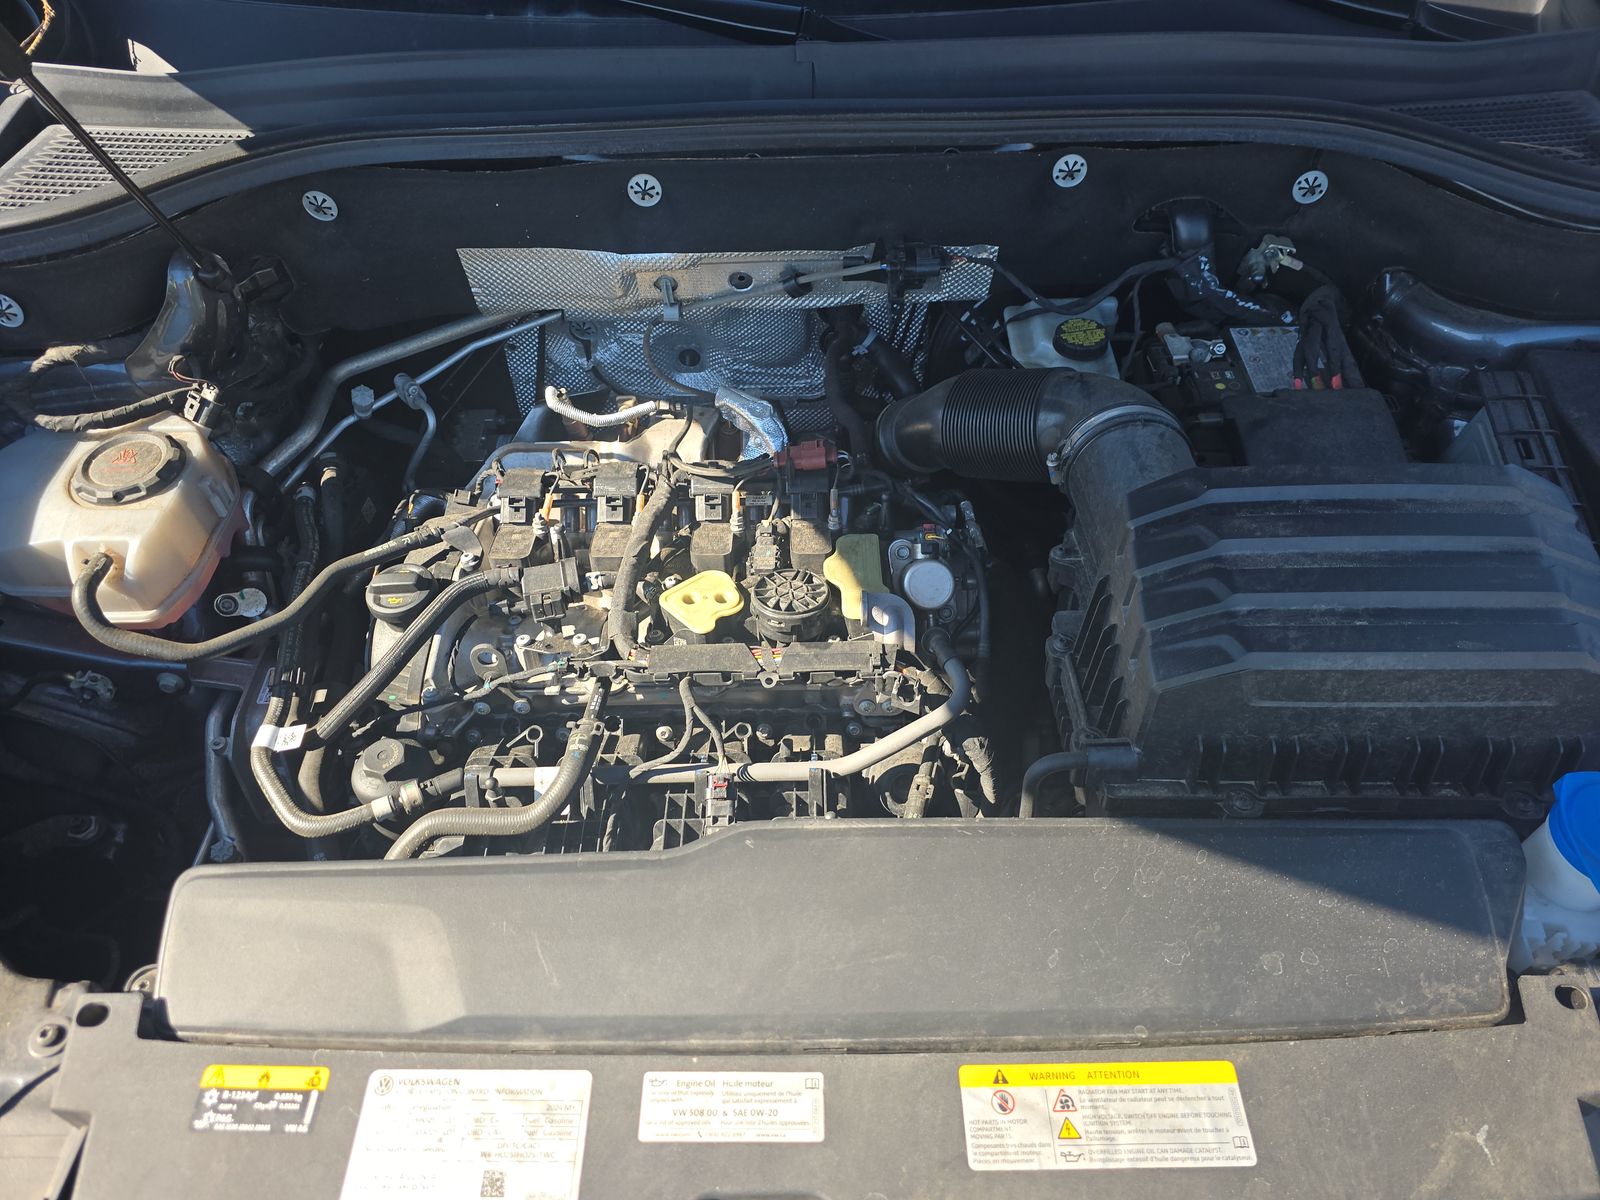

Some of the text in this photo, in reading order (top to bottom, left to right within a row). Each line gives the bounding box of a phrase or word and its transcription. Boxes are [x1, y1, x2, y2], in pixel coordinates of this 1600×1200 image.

[1029, 1070, 1140, 1081] WARNING ATTENTION
[399, 1078, 462, 1086] VOLKSWAGEN
[676, 1080, 703, 1089] Engine
[705, 1079, 716, 1087] Oil
[672, 1109, 688, 1117] VW
[689, 1109, 704, 1117] 508
[706, 1109, 718, 1117] 00
[733, 1109, 748, 1117] SAE
[750, 1109, 778, 1117] 0W-20
